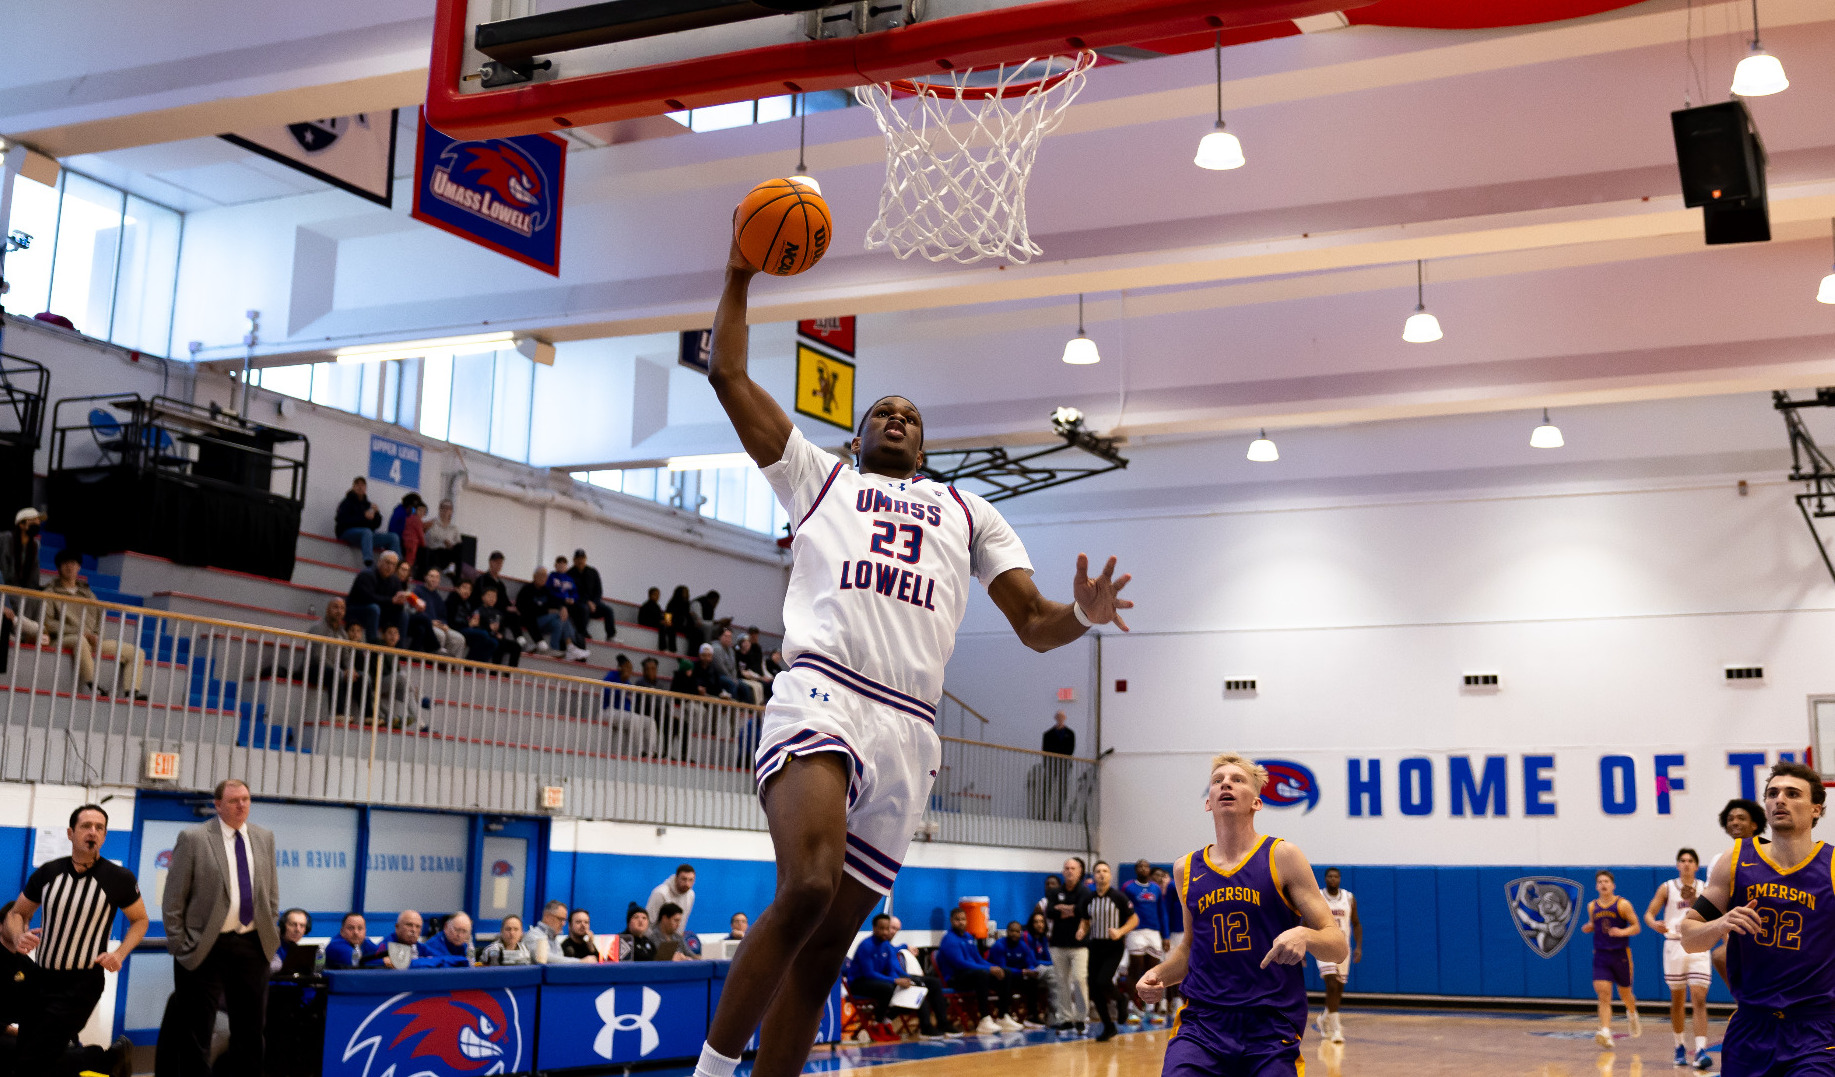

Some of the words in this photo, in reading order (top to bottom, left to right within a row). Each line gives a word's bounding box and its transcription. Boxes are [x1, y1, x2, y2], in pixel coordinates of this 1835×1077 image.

[480, 190, 531, 233] LOWELL
[389, 458, 402, 483] 4
[856, 487, 942, 527] UMASS
[869, 519, 924, 565] 23
[839, 559, 936, 612] LOWELL
[154, 752, 176, 777] EXIT
[1347, 754, 1558, 817] HOME
[1599, 753, 1687, 815] OF
[1197, 886, 1262, 915] EMERSON
[1746, 882, 1817, 911] EMERSON
[1212, 911, 1252, 954] 12
[1753, 906, 1804, 951] 32
